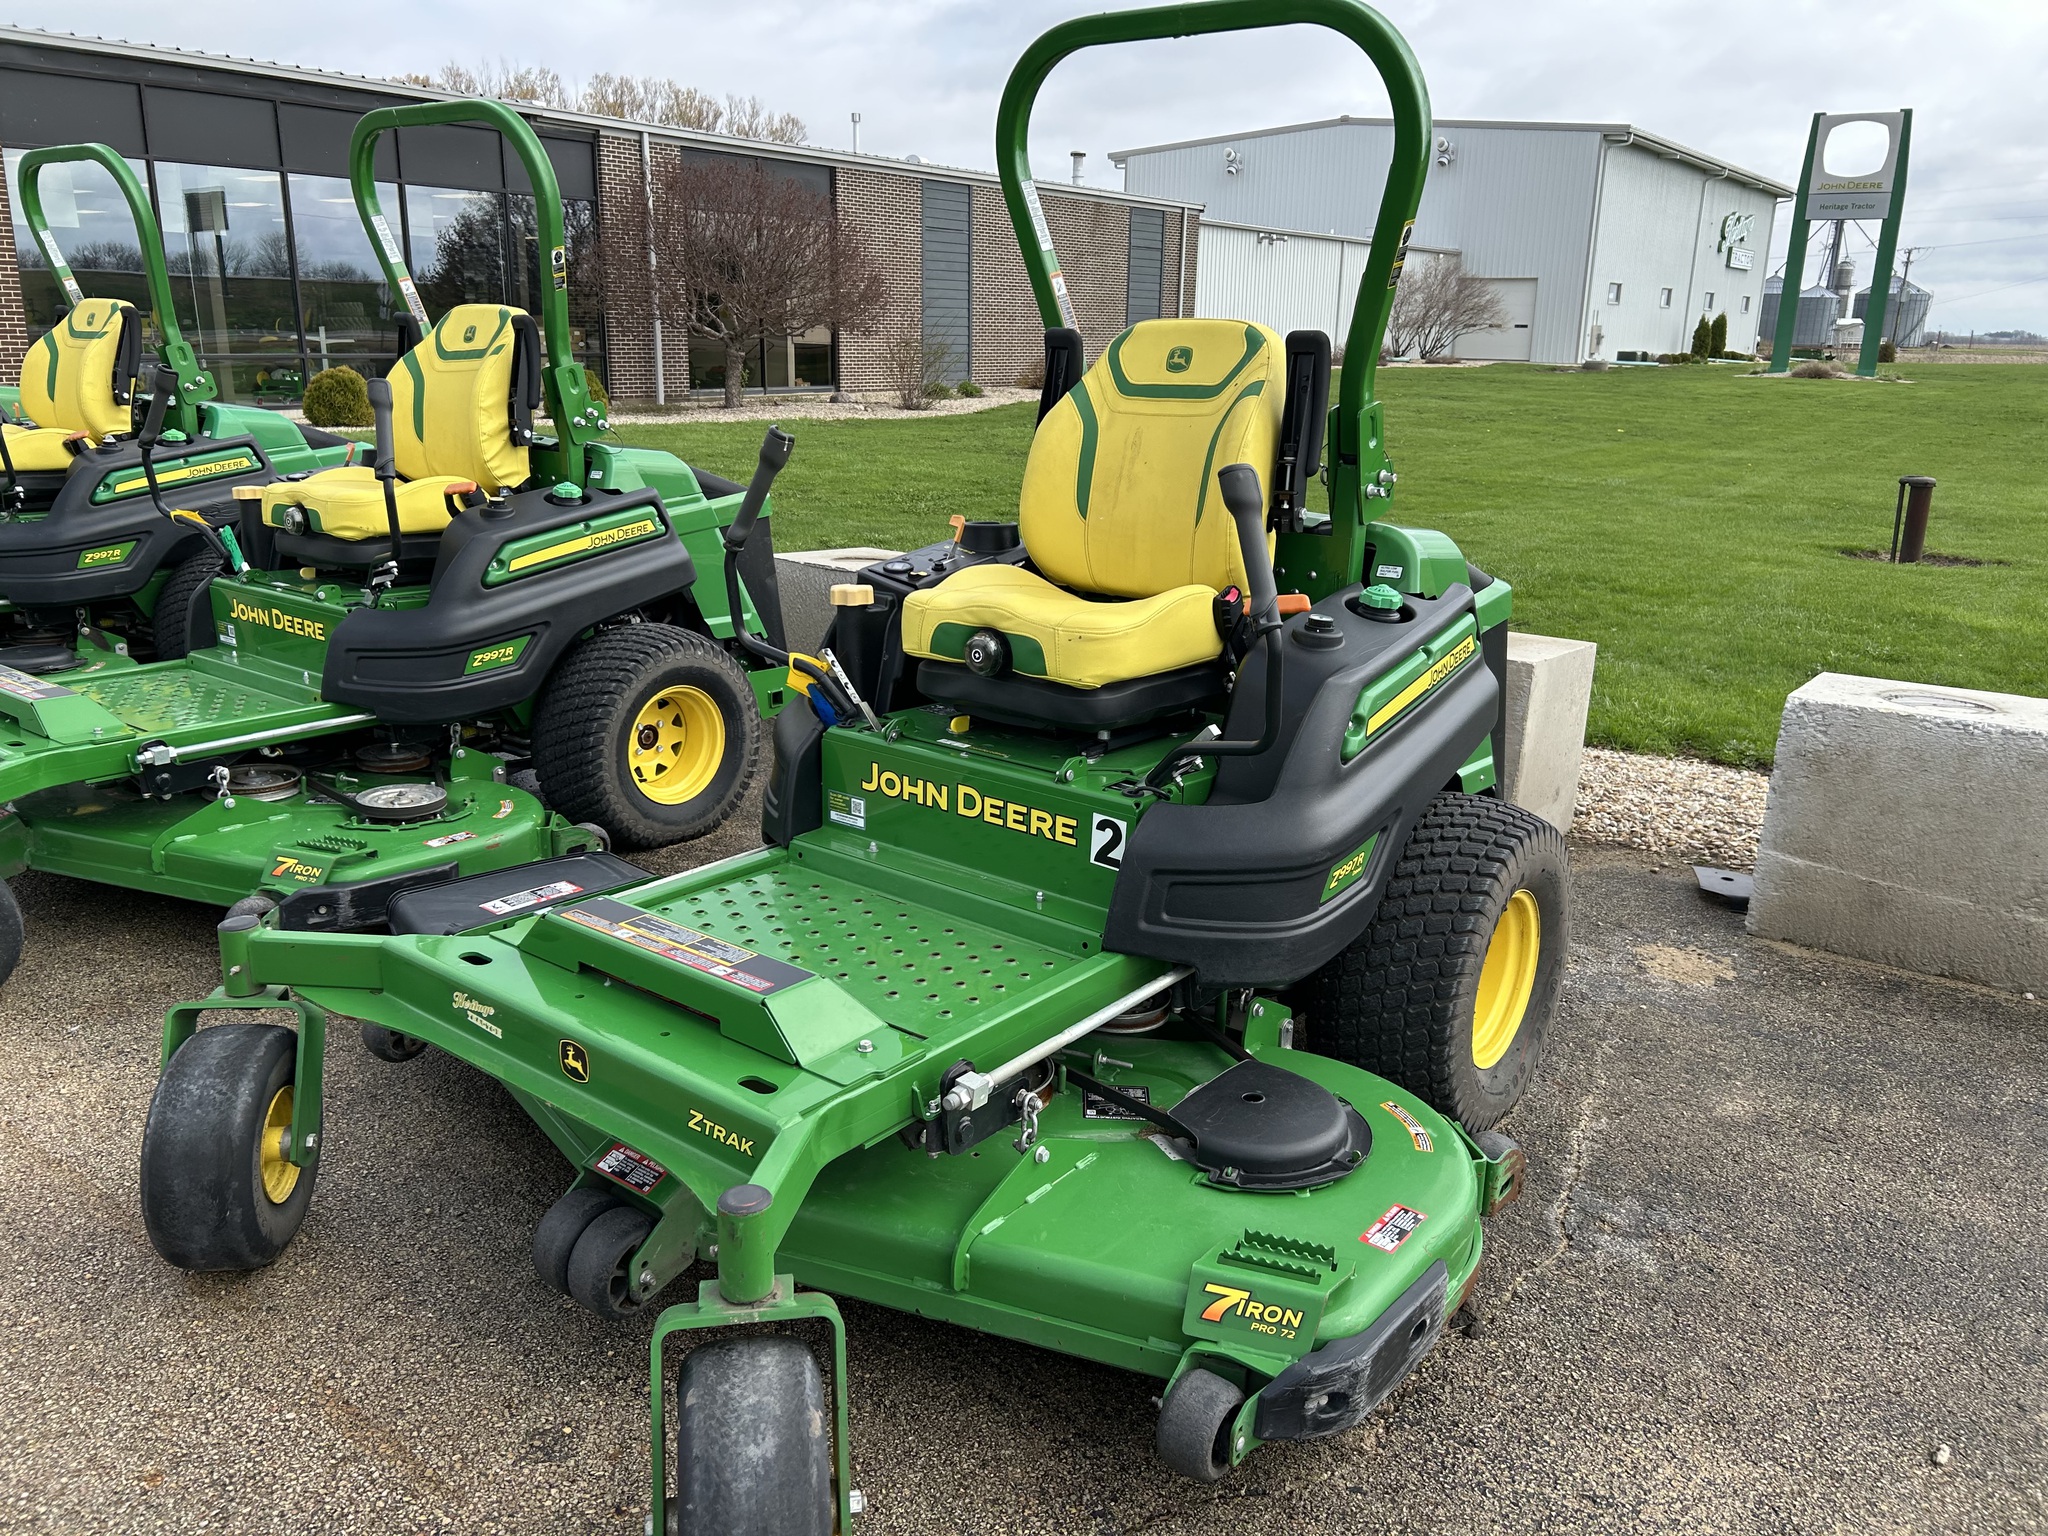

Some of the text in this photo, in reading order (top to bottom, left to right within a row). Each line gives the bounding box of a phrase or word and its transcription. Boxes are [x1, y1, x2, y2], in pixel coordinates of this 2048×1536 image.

[1817, 181, 1883, 190] JOHN DEERE
[1819, 202, 1876, 211] Heritage Tractor
[187, 460, 246, 478] JOHN DEERE
[588, 523, 649, 549] JOHN DEERE
[84, 549, 121, 563] Z997R
[230, 598, 270, 627] JOHN
[271, 608, 325, 641] DEERE
[472, 646, 514, 667] Z997R
[1428, 641, 1471, 688] JOHN DEERE
[862, 762, 1078, 846] JOHN DEERE
[1094, 818, 1123, 869] 2
[294, 874, 308, 882] PRO
[1329, 851, 1365, 889] Z997R
[1250, 1322, 1296, 1339] PRO 72
